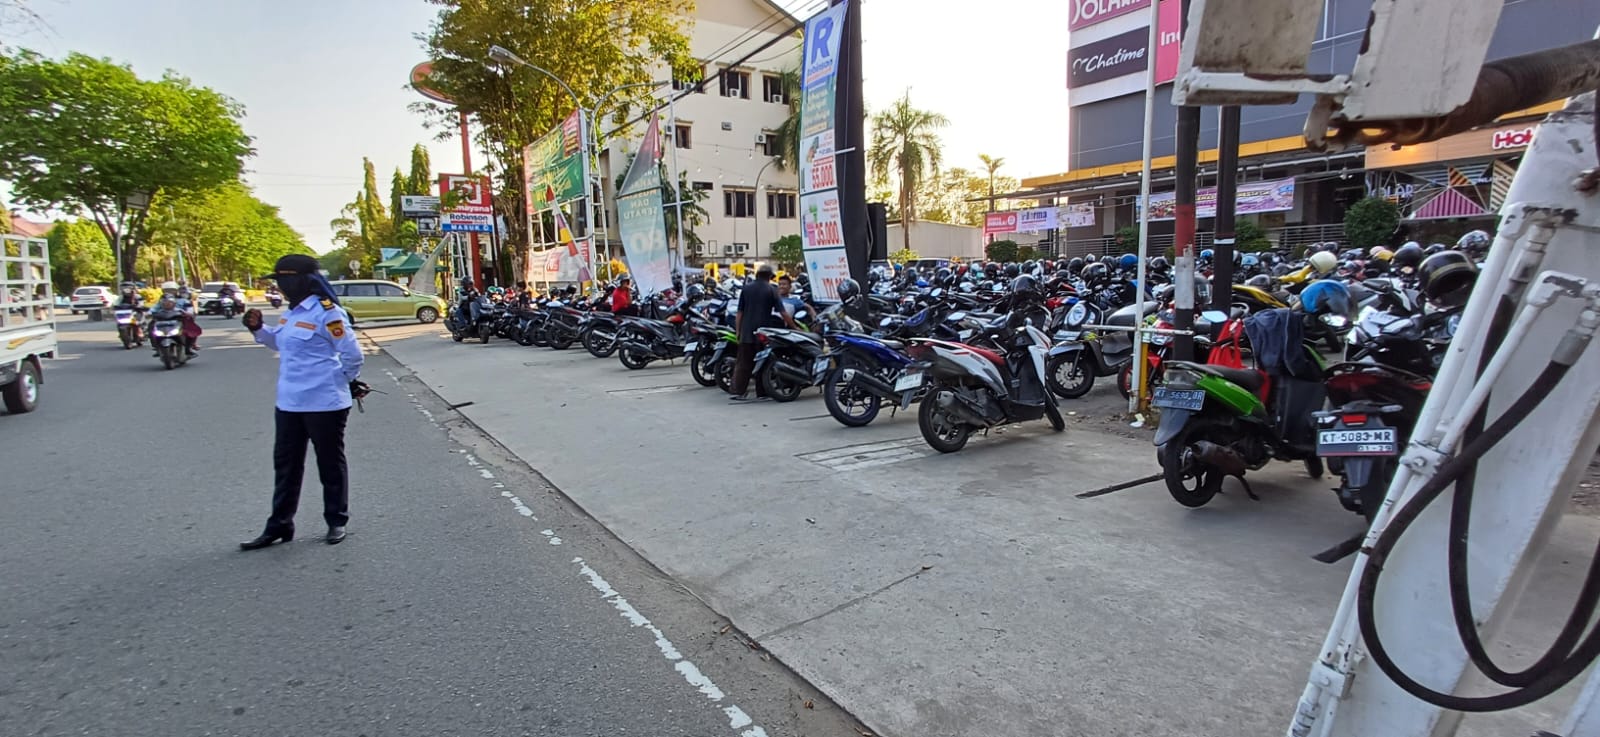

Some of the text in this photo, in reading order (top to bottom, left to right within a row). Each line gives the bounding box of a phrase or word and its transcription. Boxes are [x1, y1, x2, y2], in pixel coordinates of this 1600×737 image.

[811, 17, 834, 65] R
[1085, 48, 1145, 72] Chatime
[1322, 433, 1337, 443] KT
[1374, 431, 1392, 441] MR
